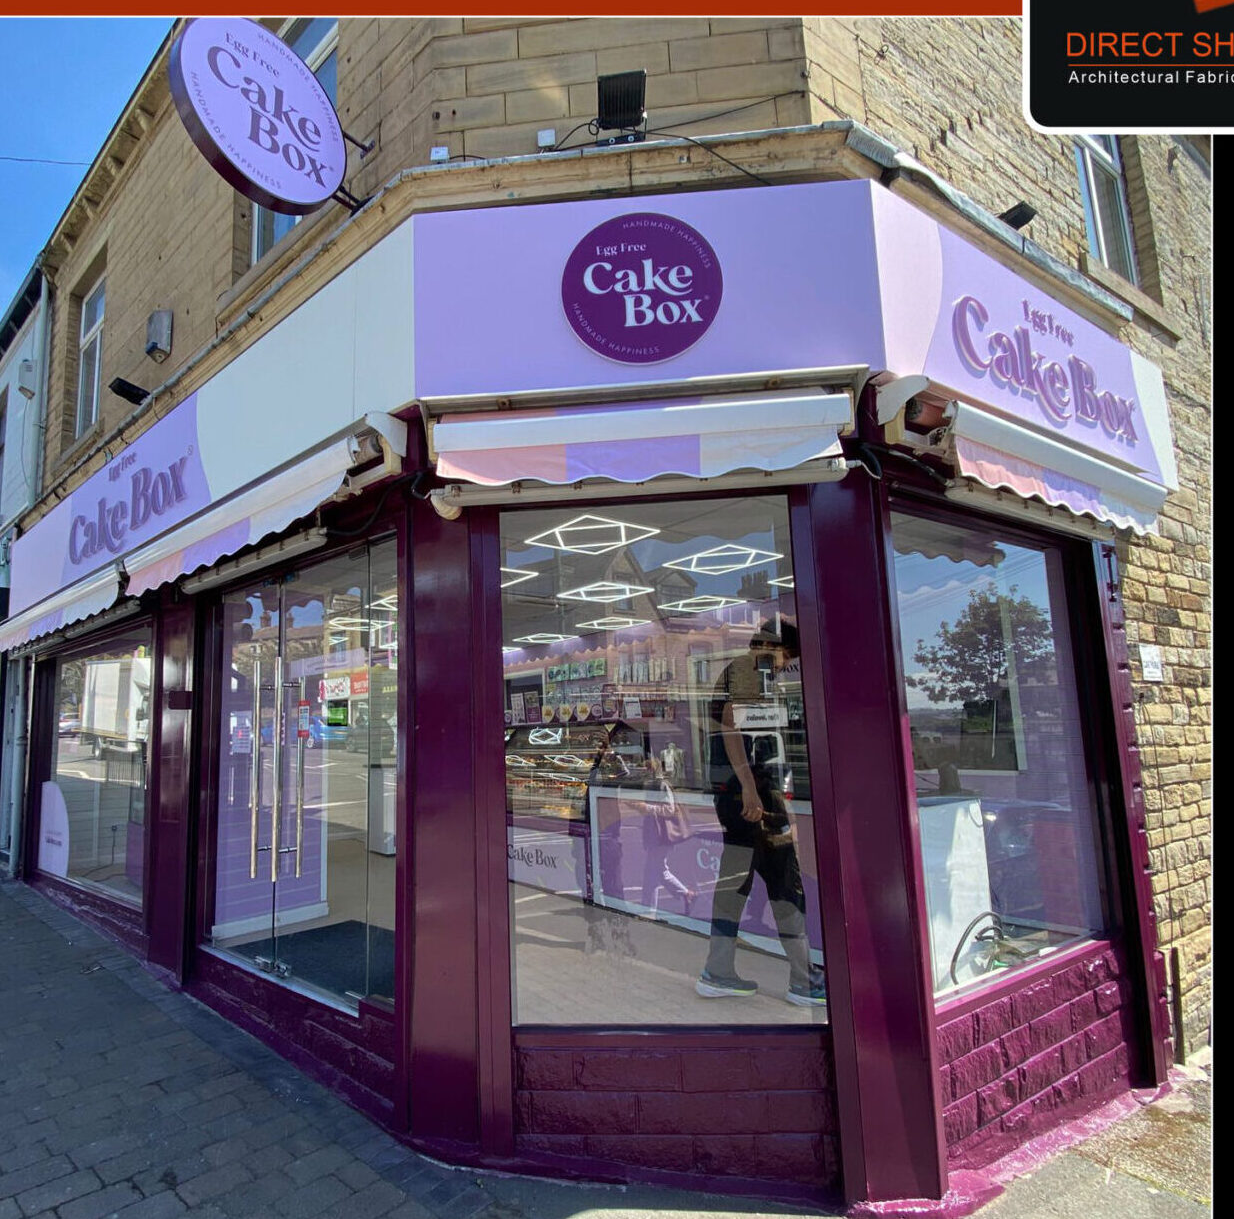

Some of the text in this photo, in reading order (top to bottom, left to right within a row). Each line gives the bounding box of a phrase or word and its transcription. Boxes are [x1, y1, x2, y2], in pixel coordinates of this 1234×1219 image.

[225, 32, 280, 78] Egg Free
[207, 46, 321, 152] Cake
[190, 71, 282, 189] HANDMADE HAPPINESS
[596, 243, 647, 256] Egg Free
[622, 220, 711, 269] HANDMADE HAPPINESS
[583, 258, 693, 296] Cake
[573, 303, 660, 355] HANDMADE HAPPINESS
[952, 295, 1072, 423] Cake
[69, 497, 129, 565] Cake
[507, 844, 533, 867] Cake
[696, 848, 720, 870] Ca
